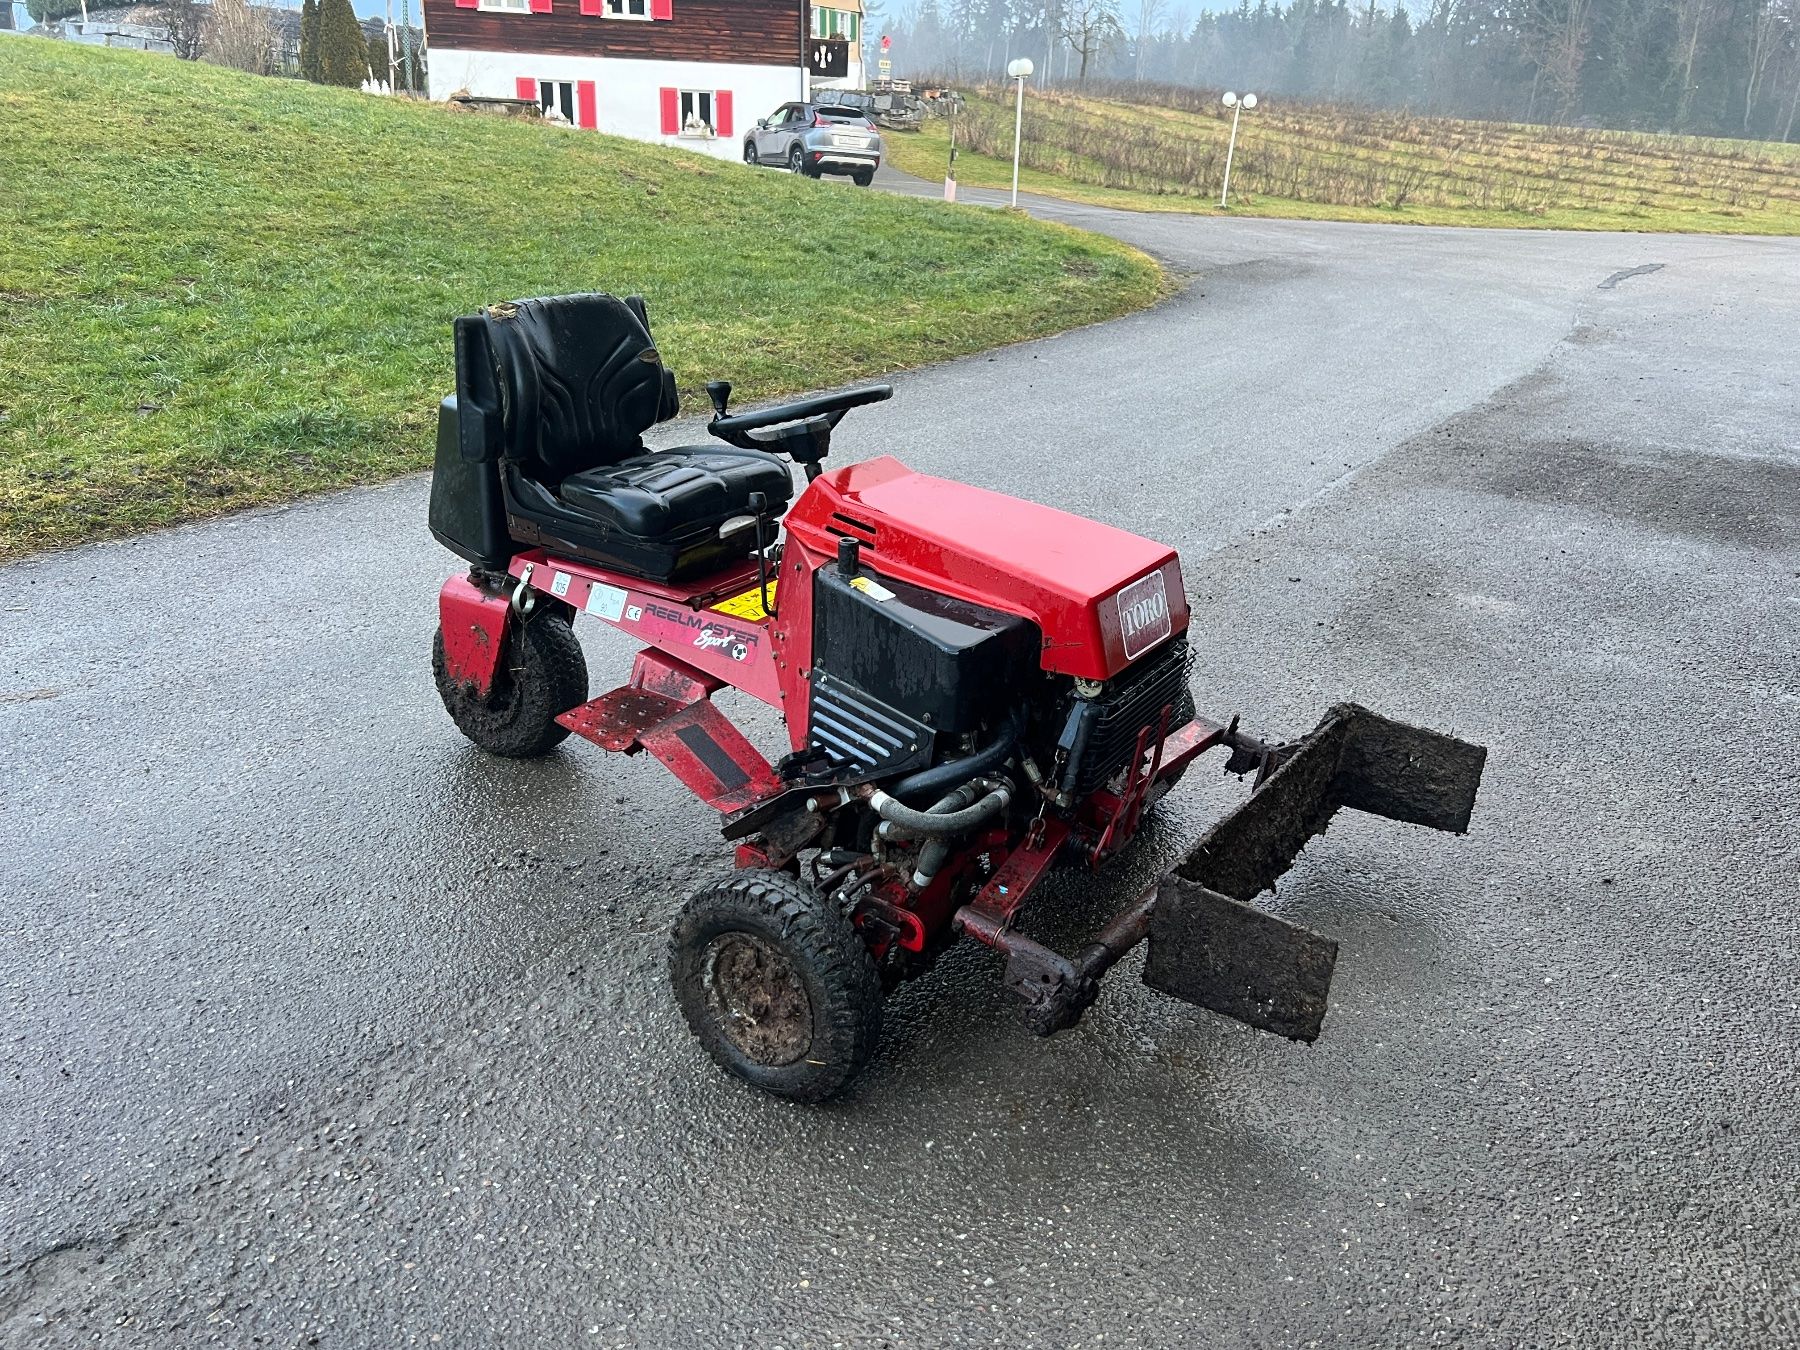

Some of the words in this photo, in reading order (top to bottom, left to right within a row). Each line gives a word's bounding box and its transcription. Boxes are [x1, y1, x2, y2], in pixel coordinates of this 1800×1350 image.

[555, 581, 566, 594] 105
[627, 607, 641, 620] CE
[1122, 592, 1164, 636] TORO
[644, 602, 759, 647] REELMASTER
[693, 629, 737, 650] Sport
